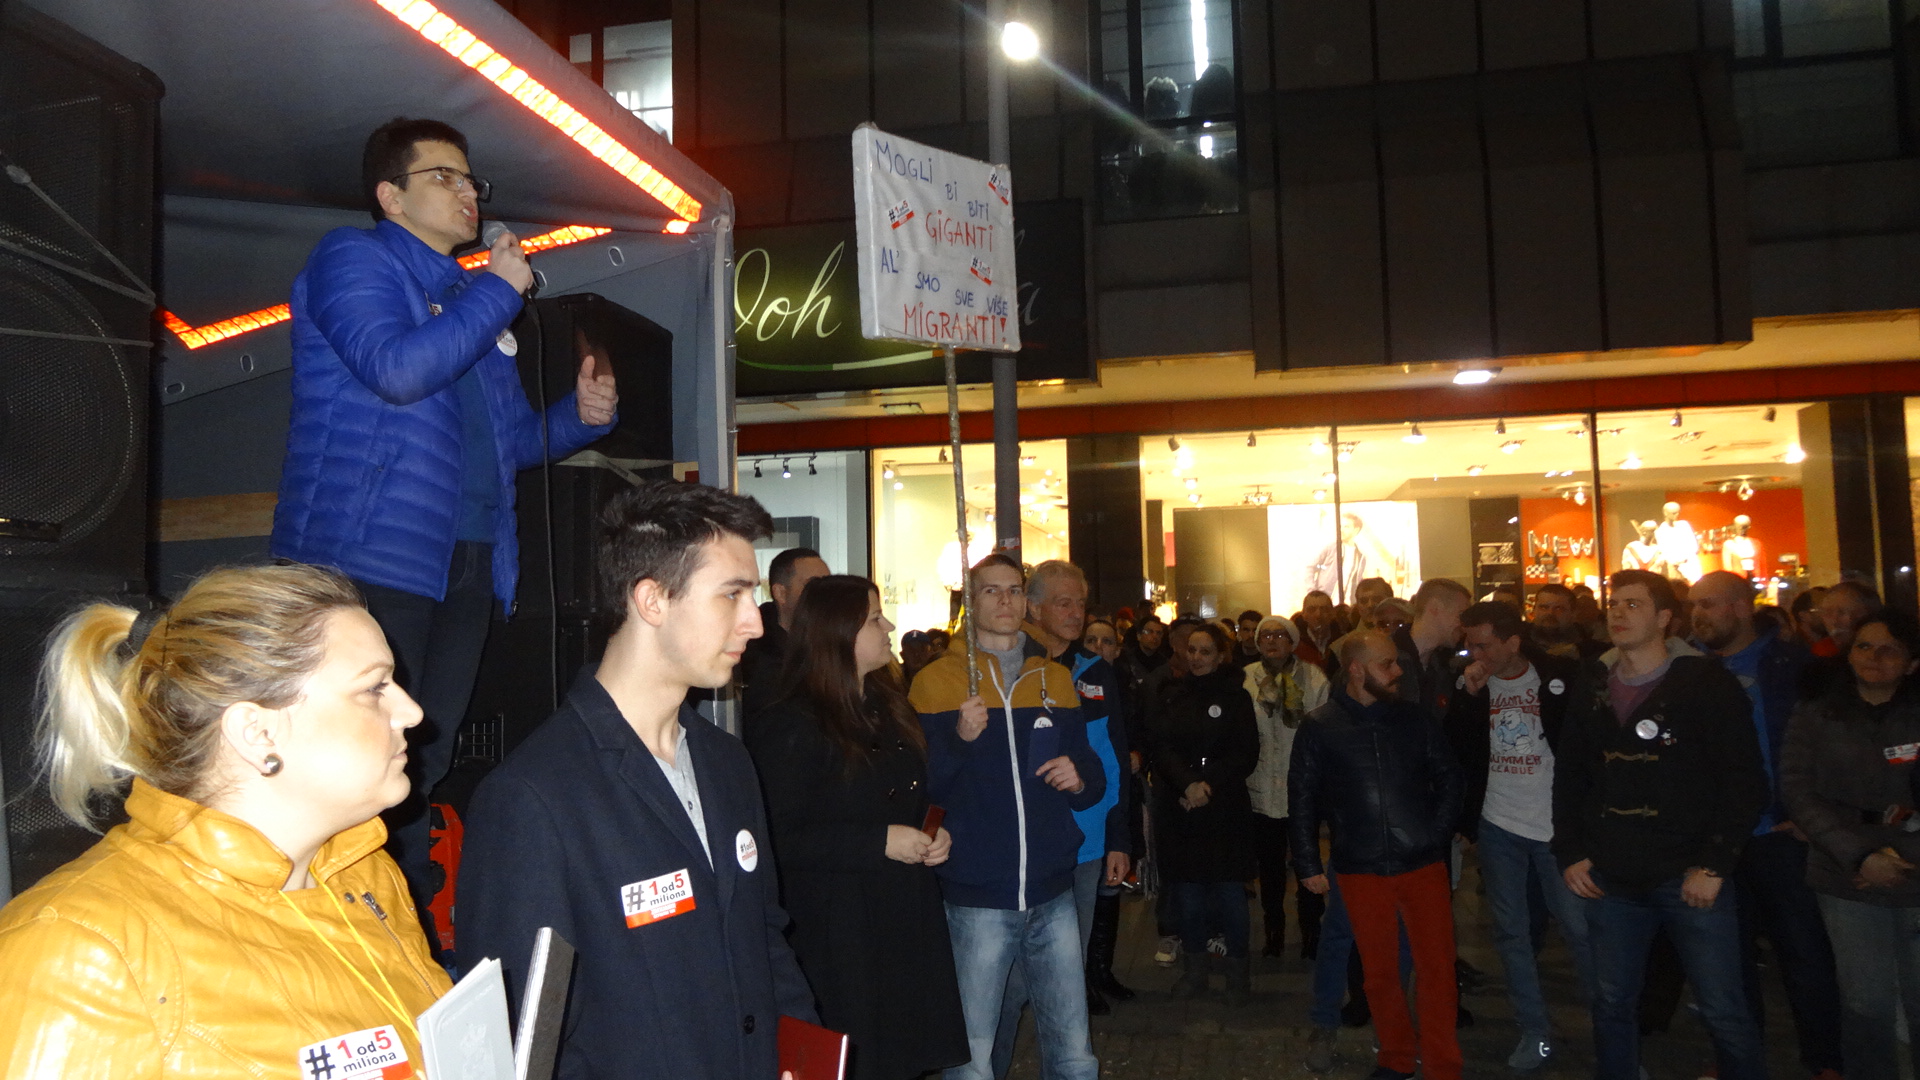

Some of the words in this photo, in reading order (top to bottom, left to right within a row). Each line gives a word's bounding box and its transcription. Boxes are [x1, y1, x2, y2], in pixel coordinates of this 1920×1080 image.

[875, 139, 933, 185] MOGLI
[968, 201, 989, 222] BITI
[925, 209, 994, 252] GIGANTI
[914, 271, 941, 293] SMO
[955, 289, 975, 308] SVE
[903, 303, 1007, 345] MIGRANTI!
[1528, 531, 1594, 558] NEW
[650, 889, 687, 906] miliona
[343, 1051, 397, 1073] miliona
